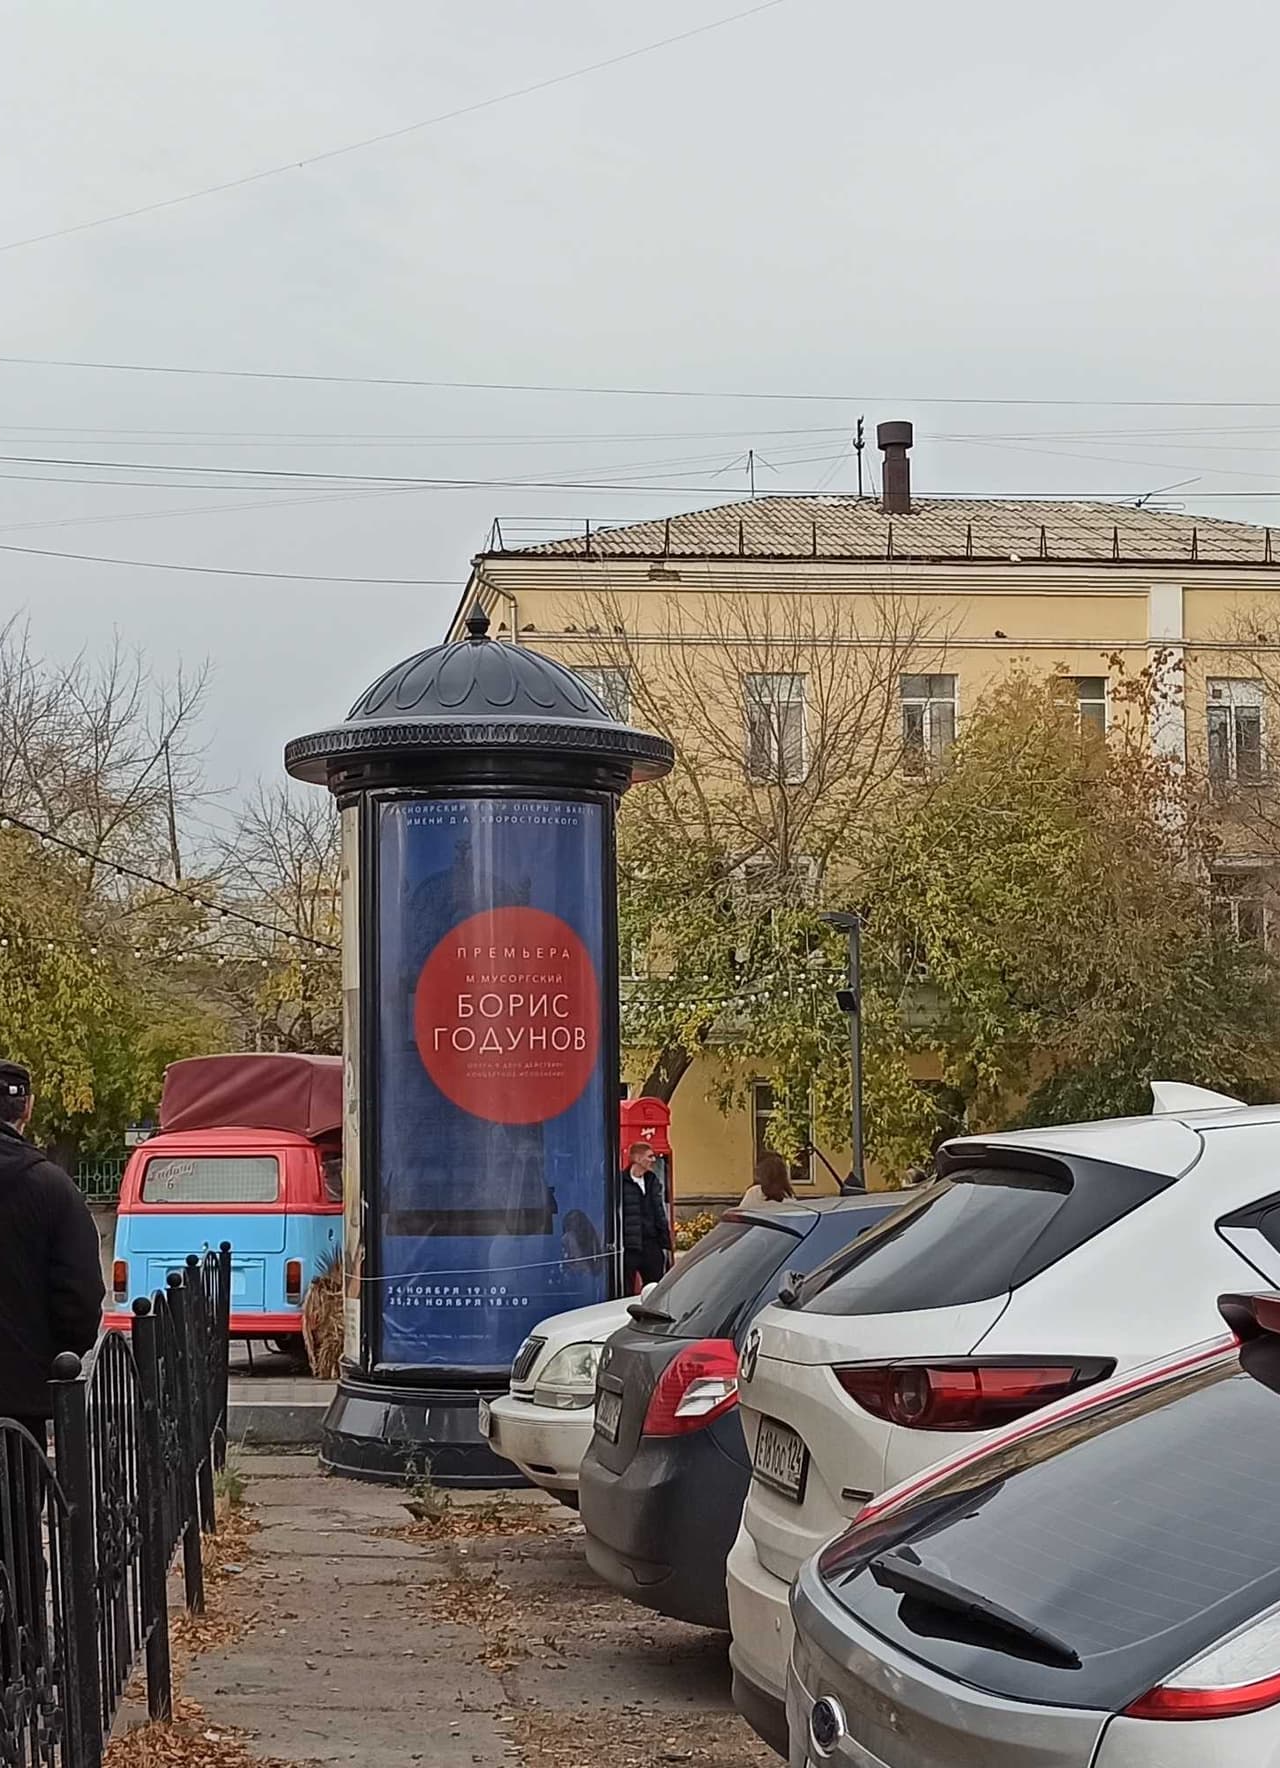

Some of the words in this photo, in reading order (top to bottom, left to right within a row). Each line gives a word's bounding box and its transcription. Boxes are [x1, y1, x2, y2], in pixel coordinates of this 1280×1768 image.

[385, 804, 467, 817] АСНОЯРСКИЙ
[513, 803, 549, 813] ОПЕРЫ
[407, 816, 443, 826] ИМЕНИ
[457, 947, 570, 960] ПРЕМЬЕРА
[458, 993, 570, 1019] БОРИС
[434, 1026, 586, 1055] ГОДУНОВ
[406, 1286, 460, 1295] НОЯБРЯ
[467, 1287, 507, 1295] 19:00
[425, 1298, 481, 1306] НОЯБРЯ
[488, 1298, 528, 1306] 18:00
